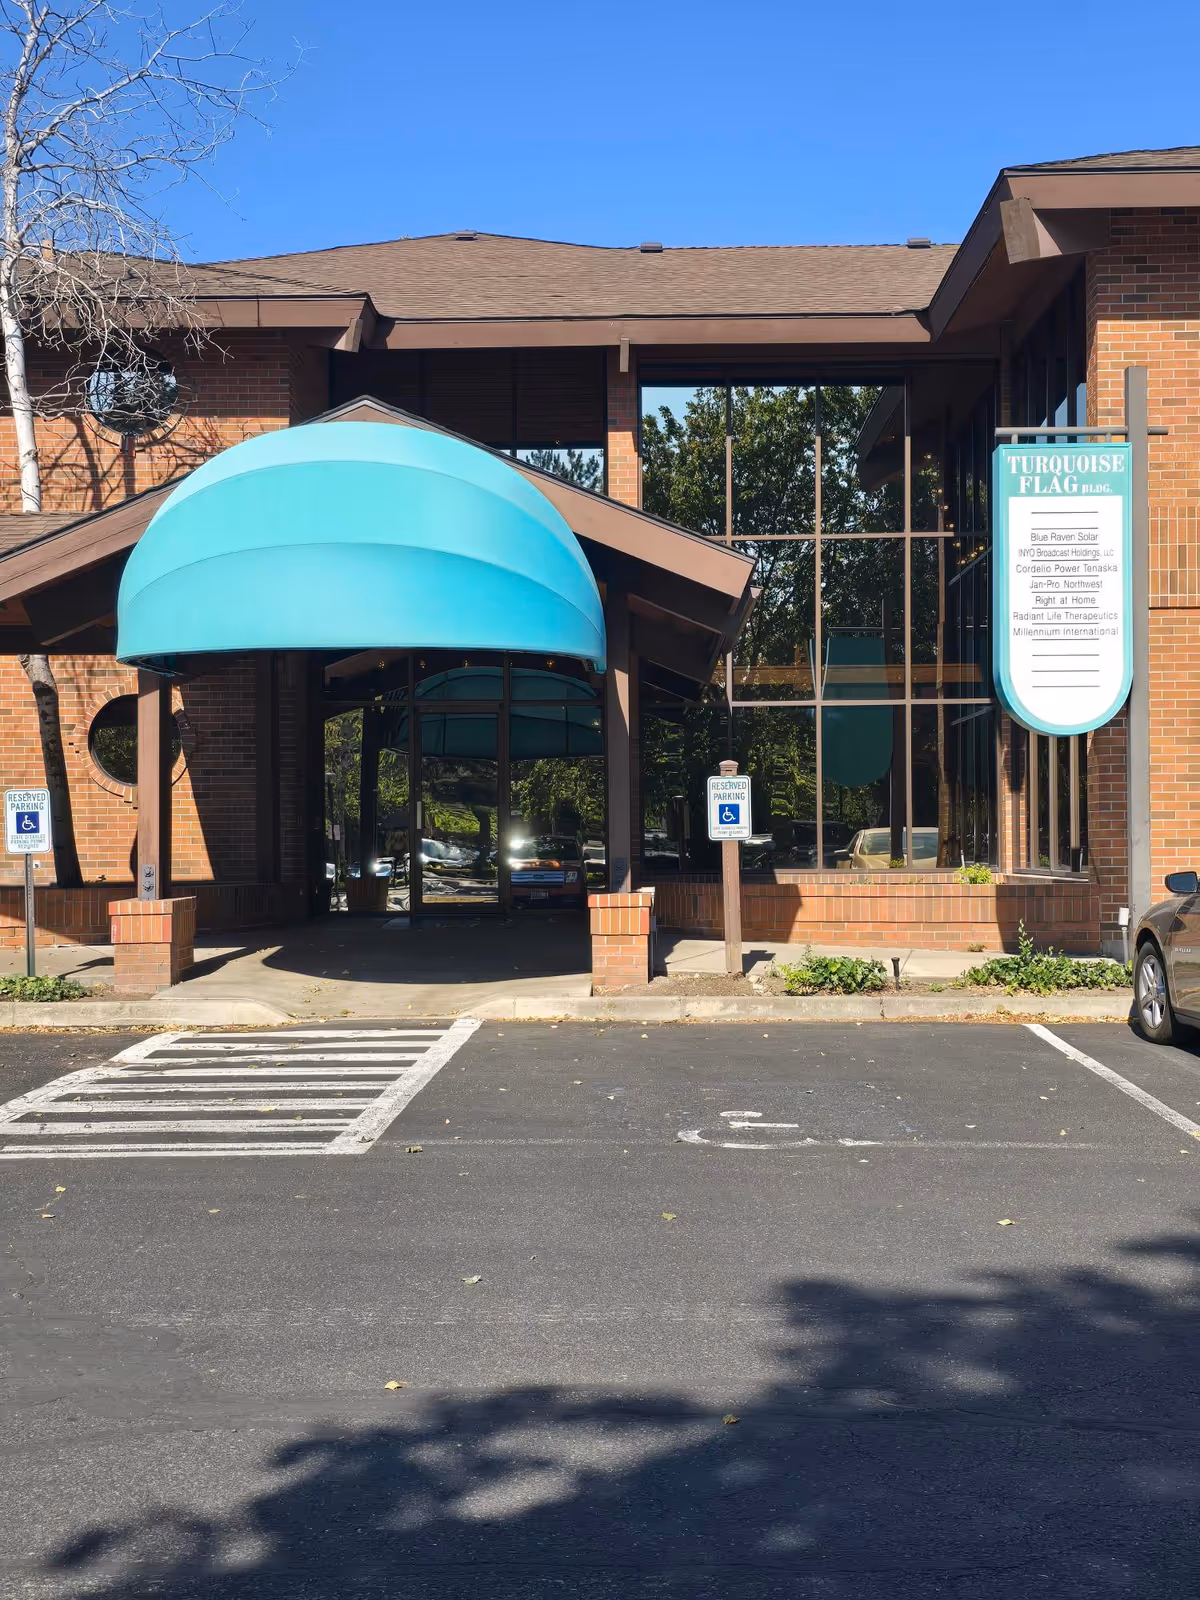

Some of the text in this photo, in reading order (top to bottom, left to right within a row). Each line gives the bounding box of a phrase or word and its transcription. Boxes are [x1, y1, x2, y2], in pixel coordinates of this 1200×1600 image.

[1007, 454, 1125, 475] TURQUOISE
[1018, 475, 1079, 494] FLAG
[1030, 531, 1099, 542] Blue Raven Solar
[1018, 548, 1035, 558] INYO
[1036, 548, 1070, 558] Broadcast
[1015, 563, 1119, 574] Cordelio Power Tenaska
[1029, 579, 1103, 590] Jan-Pro Northwest
[1035, 595, 1097, 607] Right at Home
[1012, 611, 1119, 622] Radiant Life Therapeutics
[1013, 626, 1119, 637] Millennium International
[712, 781, 747, 790] RESERVED
[8, 793, 46, 802] RESERVED
[713, 792, 746, 801] PARKING
[10, 802, 44, 811] PARKING
